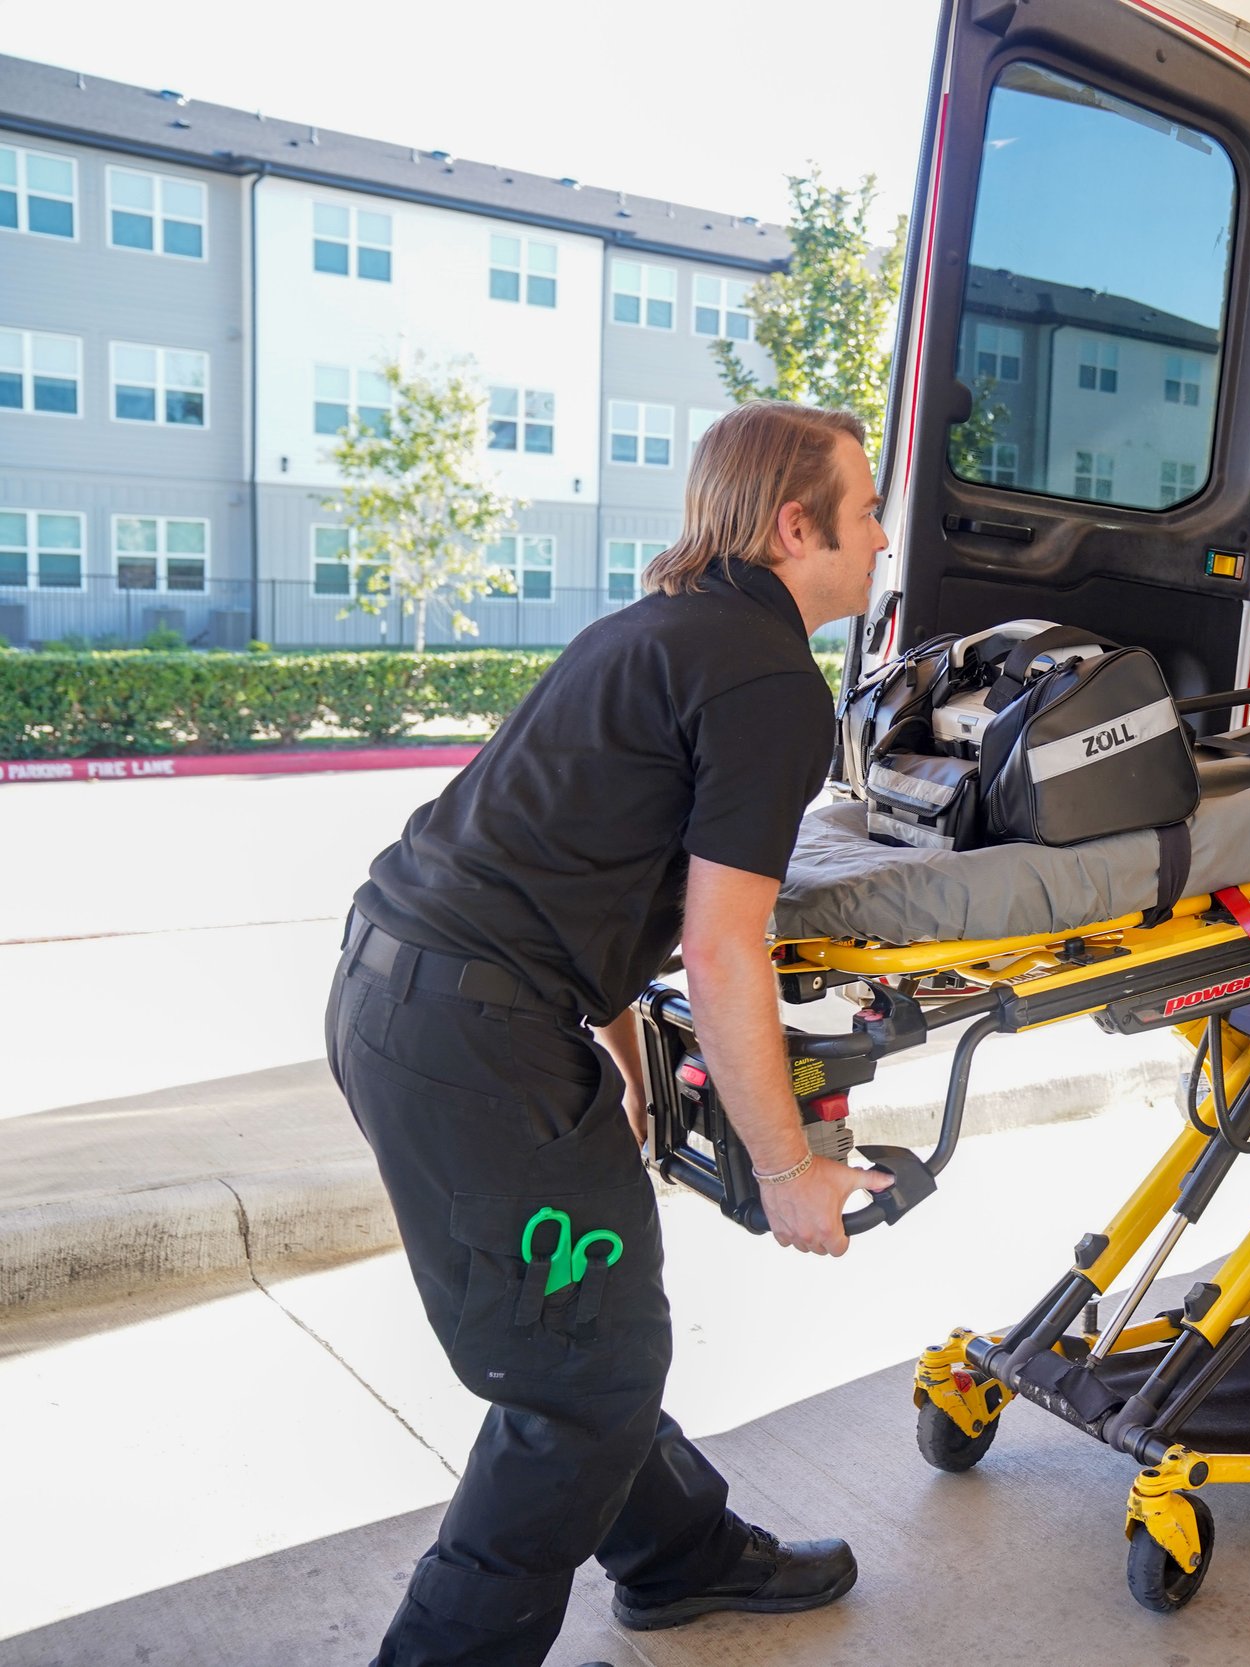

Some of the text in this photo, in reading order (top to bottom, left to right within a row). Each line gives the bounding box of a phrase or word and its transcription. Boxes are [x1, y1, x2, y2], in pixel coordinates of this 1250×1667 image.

[1082, 723, 1135, 757] ZOLL
[8, 763, 74, 780] PARKING
[87, 761, 127, 777] FIRE
[131, 759, 176, 775] LANE
[772, 1159, 811, 1183] HOUSTON
